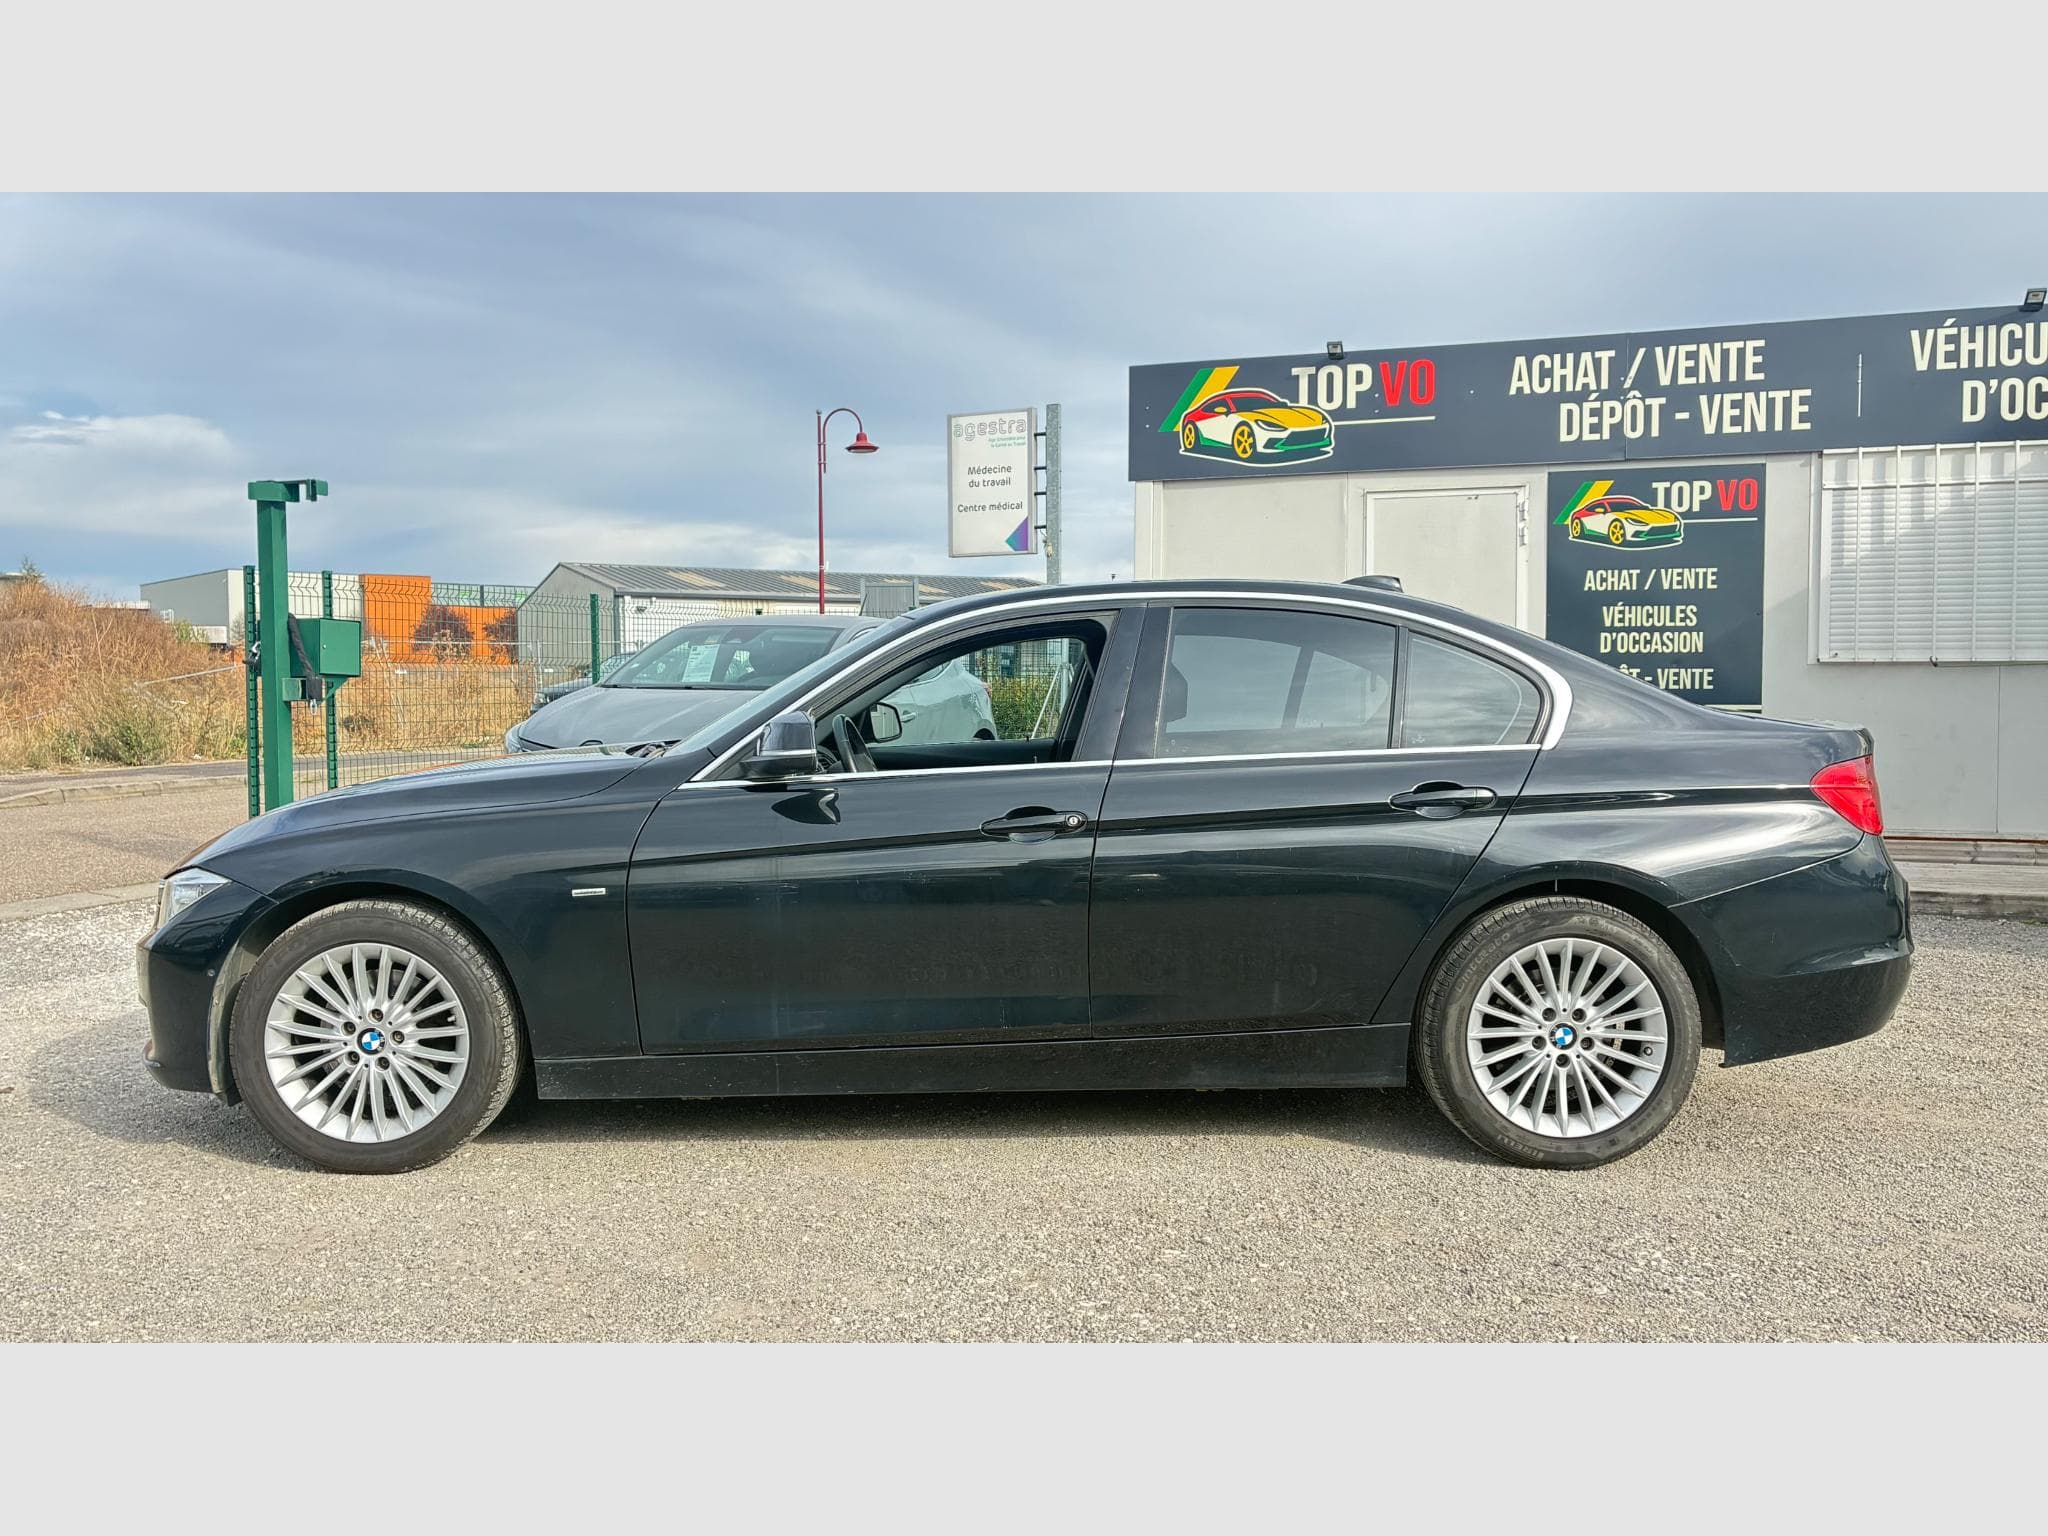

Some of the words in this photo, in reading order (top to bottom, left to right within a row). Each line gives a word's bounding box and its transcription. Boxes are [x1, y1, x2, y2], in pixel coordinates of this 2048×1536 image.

[1910, 318, 2048, 371] VÉHICU
[1508, 350, 1615, 396] ACHAT
[1623, 347, 1646, 389] /
[1654, 339, 1766, 386] VENTE
[1291, 363, 1373, 411] TOP
[1379, 359, 1436, 406] VO
[1559, 391, 1666, 442] DÉPÔT
[1699, 388, 1812, 435] VENTE
[953, 418, 1027, 441] agestra
[967, 465, 1012, 475] Médecine
[968, 479, 980, 488] du
[982, 477, 1011, 487] travail
[957, 503, 987, 513] Centre
[989, 500, 1023, 511] médical
[1652, 480, 1712, 512] TOP
[1716, 478, 1759, 511] VO
[1584, 569, 1641, 591] ACHAT
[1644, 569, 1657, 590] /
[1661, 567, 1718, 590] VENTE
[1602, 601, 1698, 627] VÉHICULES
[1600, 631, 1704, 654] D'OCCASION
[1657, 668, 1714, 690] VENTE
